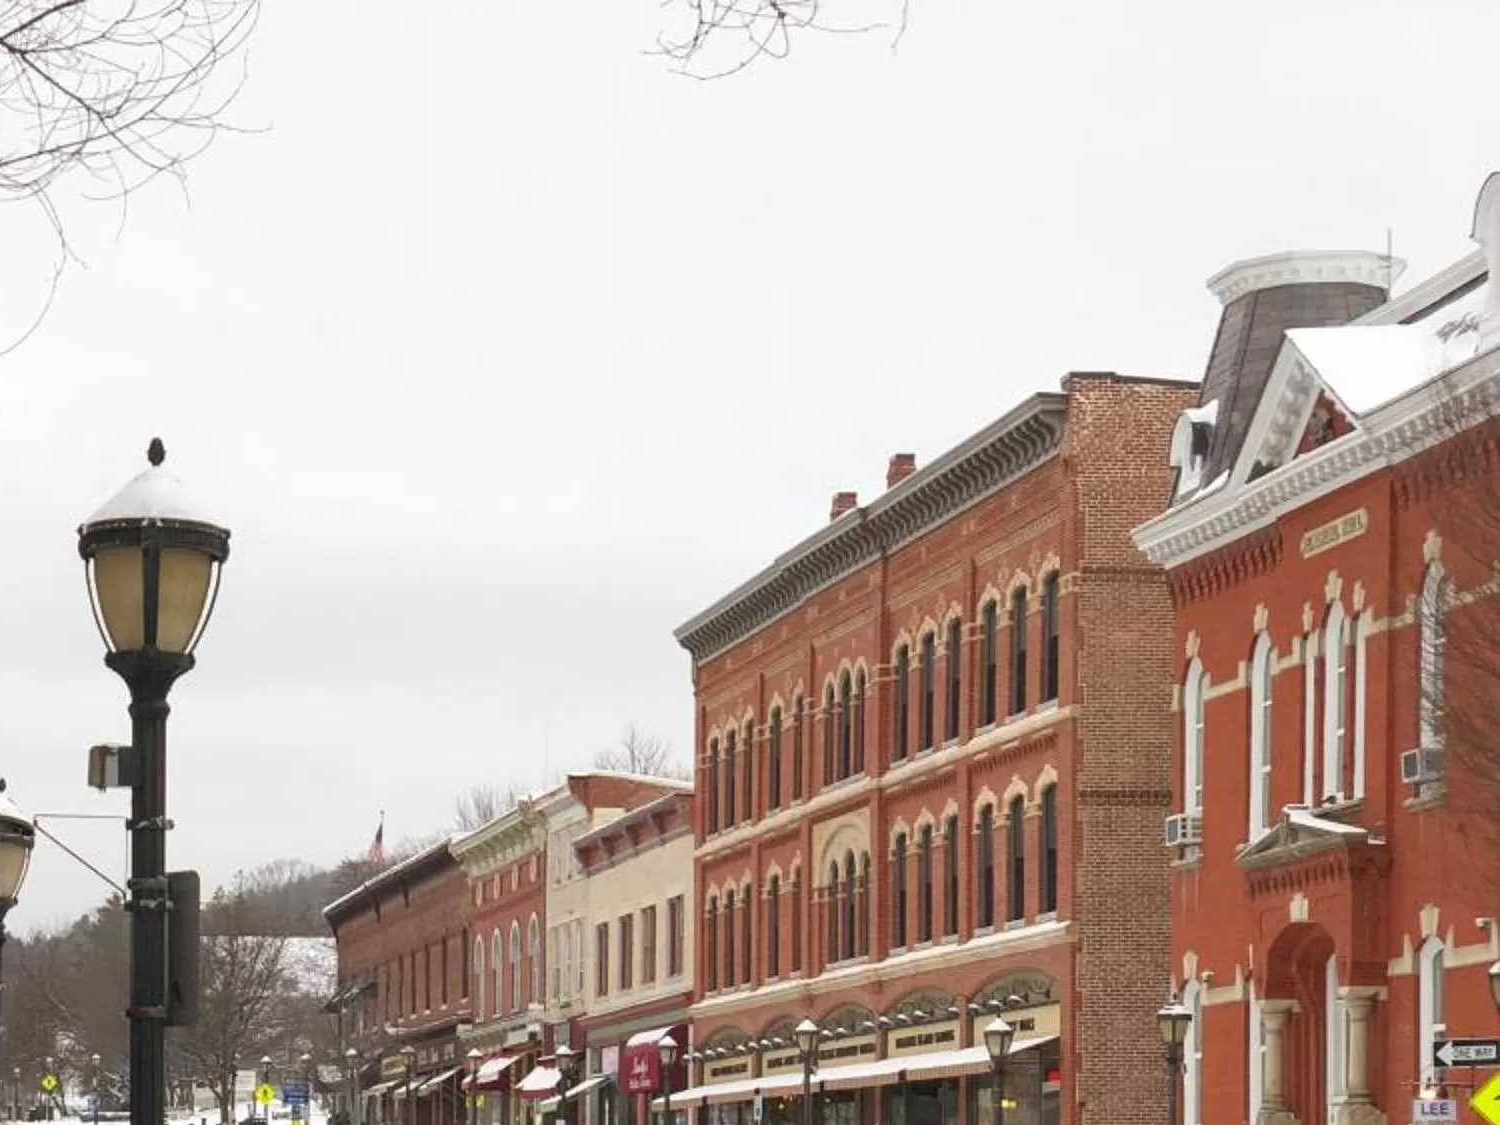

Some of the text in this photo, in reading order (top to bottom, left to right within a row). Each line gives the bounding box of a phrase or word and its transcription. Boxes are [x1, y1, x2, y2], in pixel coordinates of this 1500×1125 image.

[1453, 1046, 1494, 1059] ONE WAY
[1421, 1102, 1449, 1116] LEE
